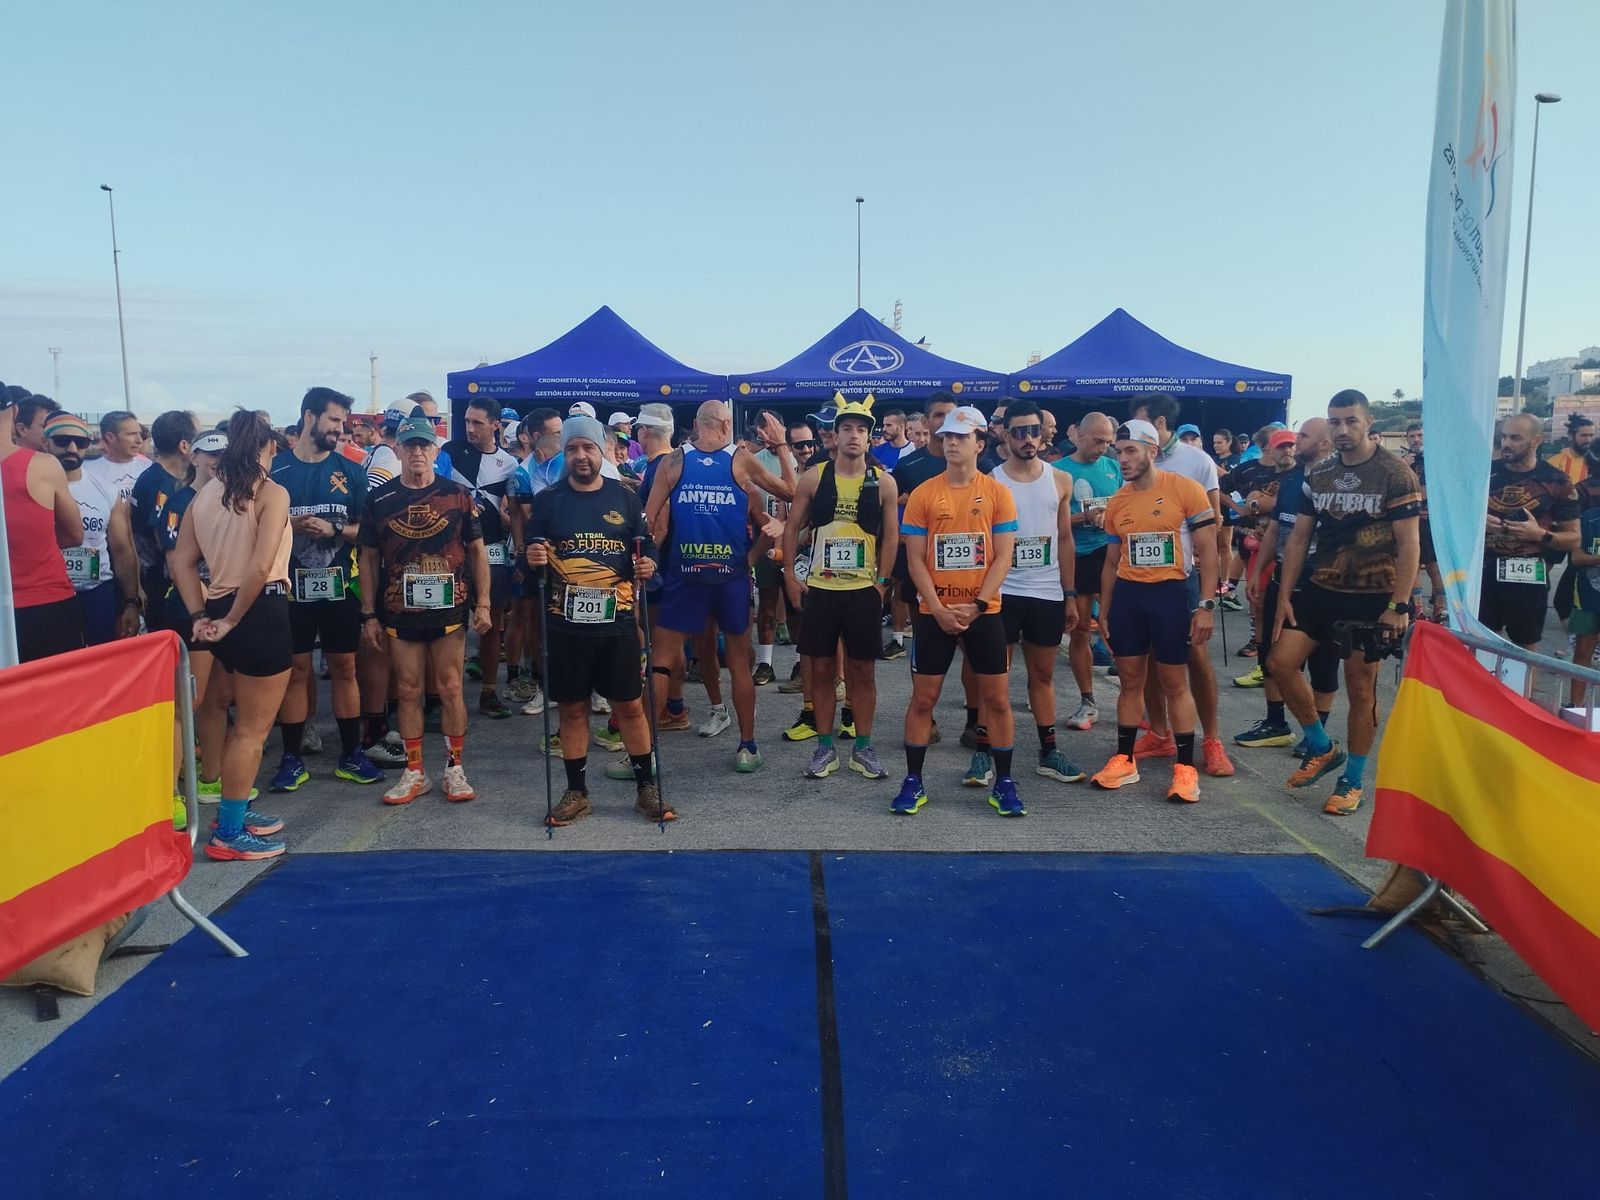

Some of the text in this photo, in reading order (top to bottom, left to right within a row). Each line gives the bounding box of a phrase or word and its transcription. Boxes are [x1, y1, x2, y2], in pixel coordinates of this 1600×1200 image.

[848, 379, 897, 387] ORGANIZACIÓN
[704, 484, 732, 492] montaña
[677, 491, 737, 505] ANYERA
[694, 504, 719, 512] CEUTA
[82, 517, 104, 531] S@S
[578, 539, 626, 552] FUERTES
[680, 543, 733, 555] VIVERA
[837, 551, 851, 560] 12
[946, 546, 971, 558] 239
[1020, 549, 1042, 560] 138
[1139, 546, 1161, 557] 130
[66, 560, 83, 571] 98
[796, 564, 807, 576] 72
[1510, 563, 1533, 574] 146
[312, 581, 327, 592] 28
[425, 588, 432, 599] 5
[577, 601, 602, 613] 201
